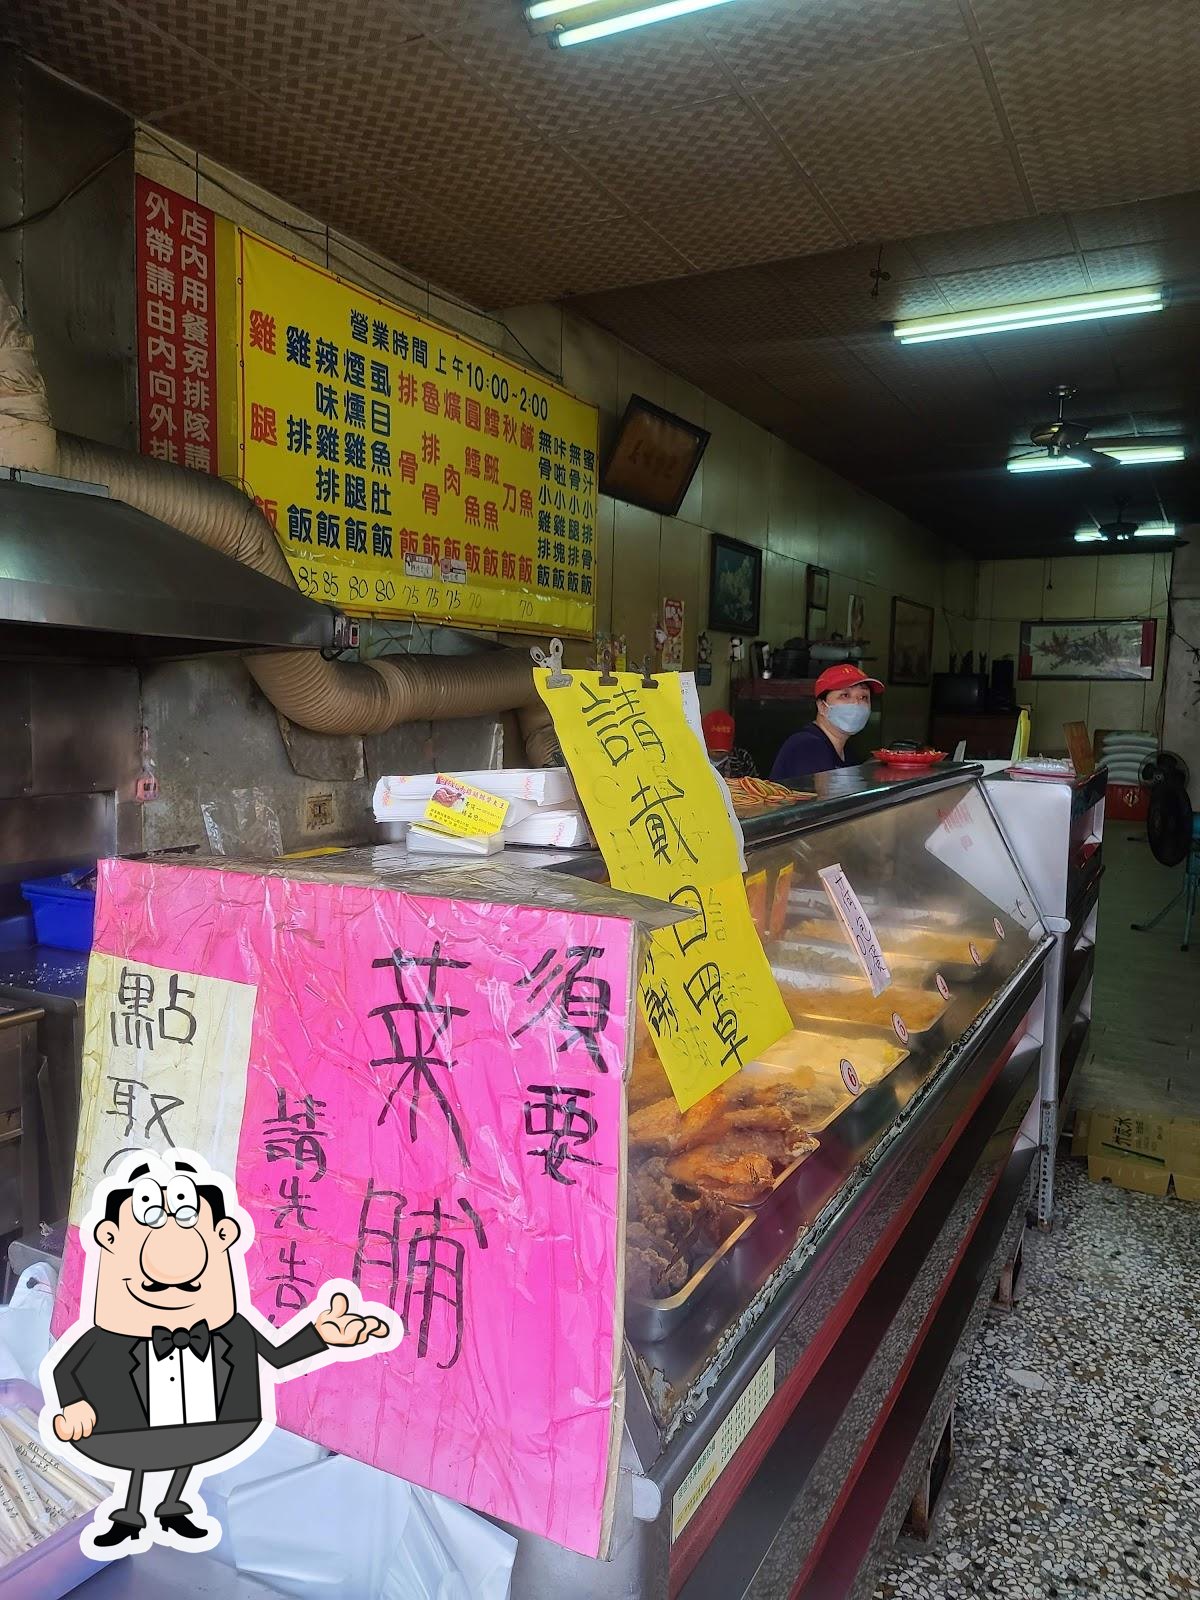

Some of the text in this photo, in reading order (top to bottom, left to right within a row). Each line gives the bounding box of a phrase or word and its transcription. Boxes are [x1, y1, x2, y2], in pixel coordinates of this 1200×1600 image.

[286, 325, 313, 546] 雞排飯
[315, 336, 341, 551] 辣味雞排飯
[350, 308, 428, 369] 營業時間
[343, 348, 368, 555] 煙燻雞腿飯
[369, 359, 394, 559] 虱目魚肚飯
[537, 429, 552, 589] 無骨小雞排飯
[375, 579, 396, 602] 80
[580, 681, 749, 1068] 請戴口罩
[104, 965, 203, 1176] 點取
[511, 944, 611, 1187] 須要
[262, 1086, 329, 1328] 請先告
